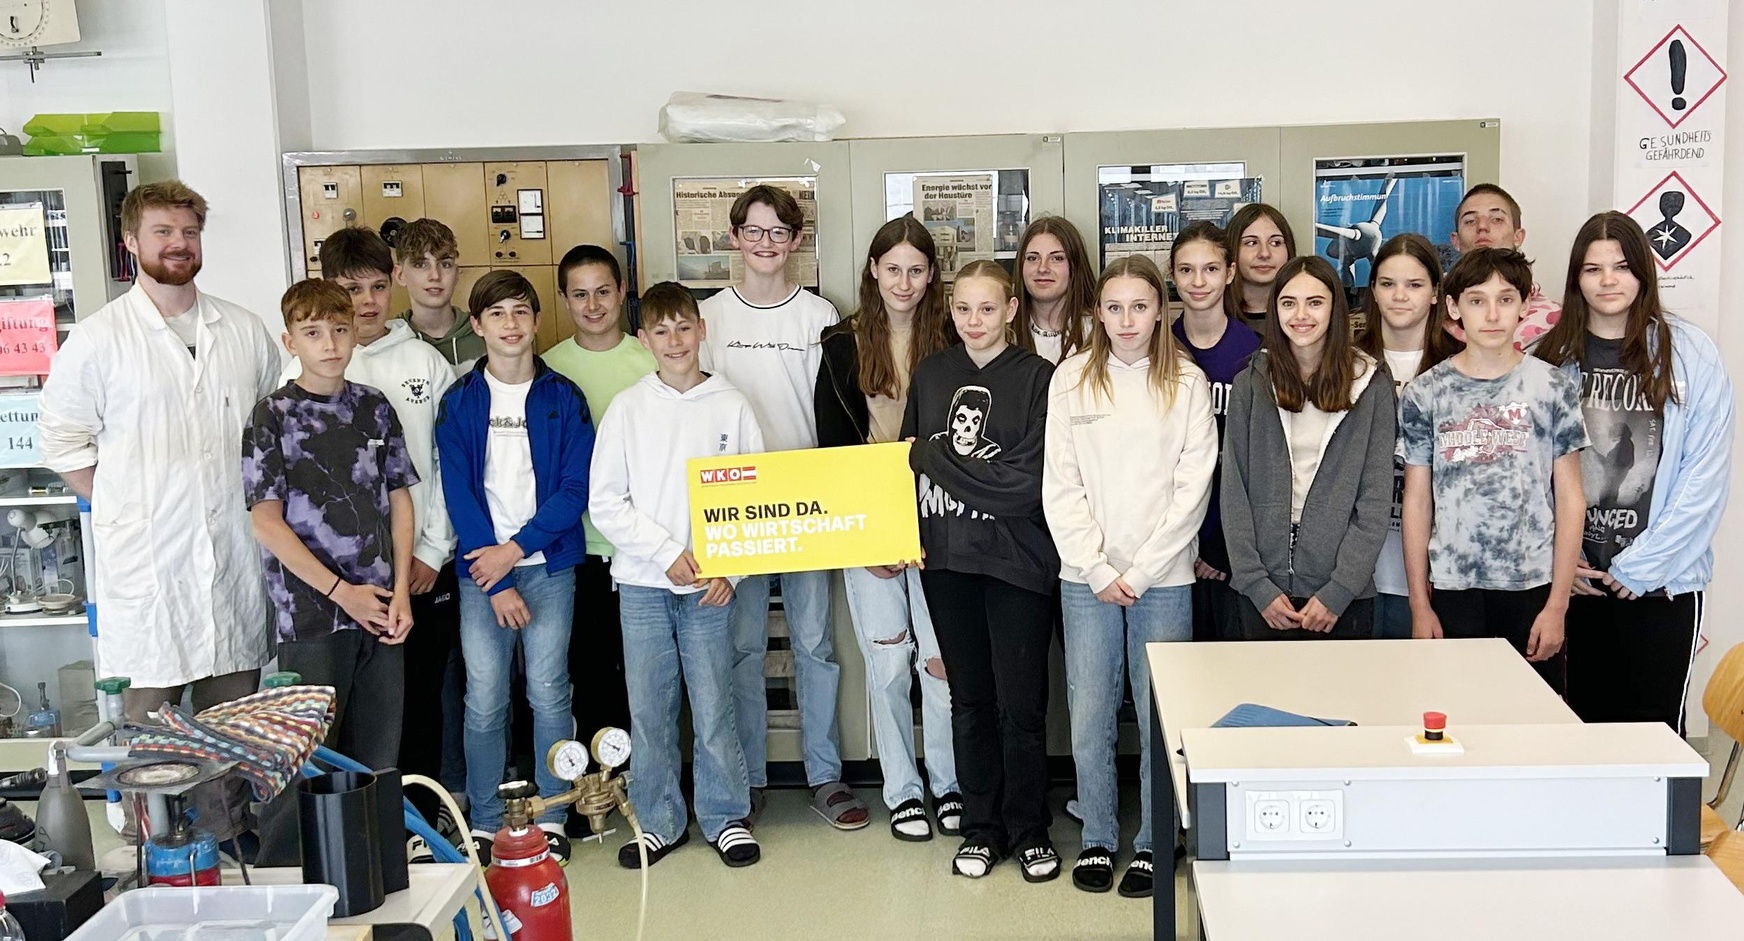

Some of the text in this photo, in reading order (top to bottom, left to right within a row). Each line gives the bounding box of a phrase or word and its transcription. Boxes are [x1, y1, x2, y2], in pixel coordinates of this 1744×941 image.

[1645, 147, 1704, 160] GEFÄHRDEND
[921, 183, 950, 192] Energie
[676, 191, 717, 199] Historische
[938, 191, 973, 199] Haustüre
[1320, 193, 1387, 203] Aufbruchstimmun
[1104, 225, 1168, 235] KLIMAKILLER
[0, 316, 49, 332] iftung
[14, 343, 28, 354] 43
[32, 342, 46, 353] 43
[8, 436, 33, 450] 144
[701, 468, 741, 482] WKO
[704, 500, 828, 522] WIR SIND DA.
[705, 514, 867, 541] WO WIRTSCHAFT
[705, 537, 803, 559] PASSIERT.
[960, 846, 990, 858] FILA
[1025, 847, 1055, 861] FILA
